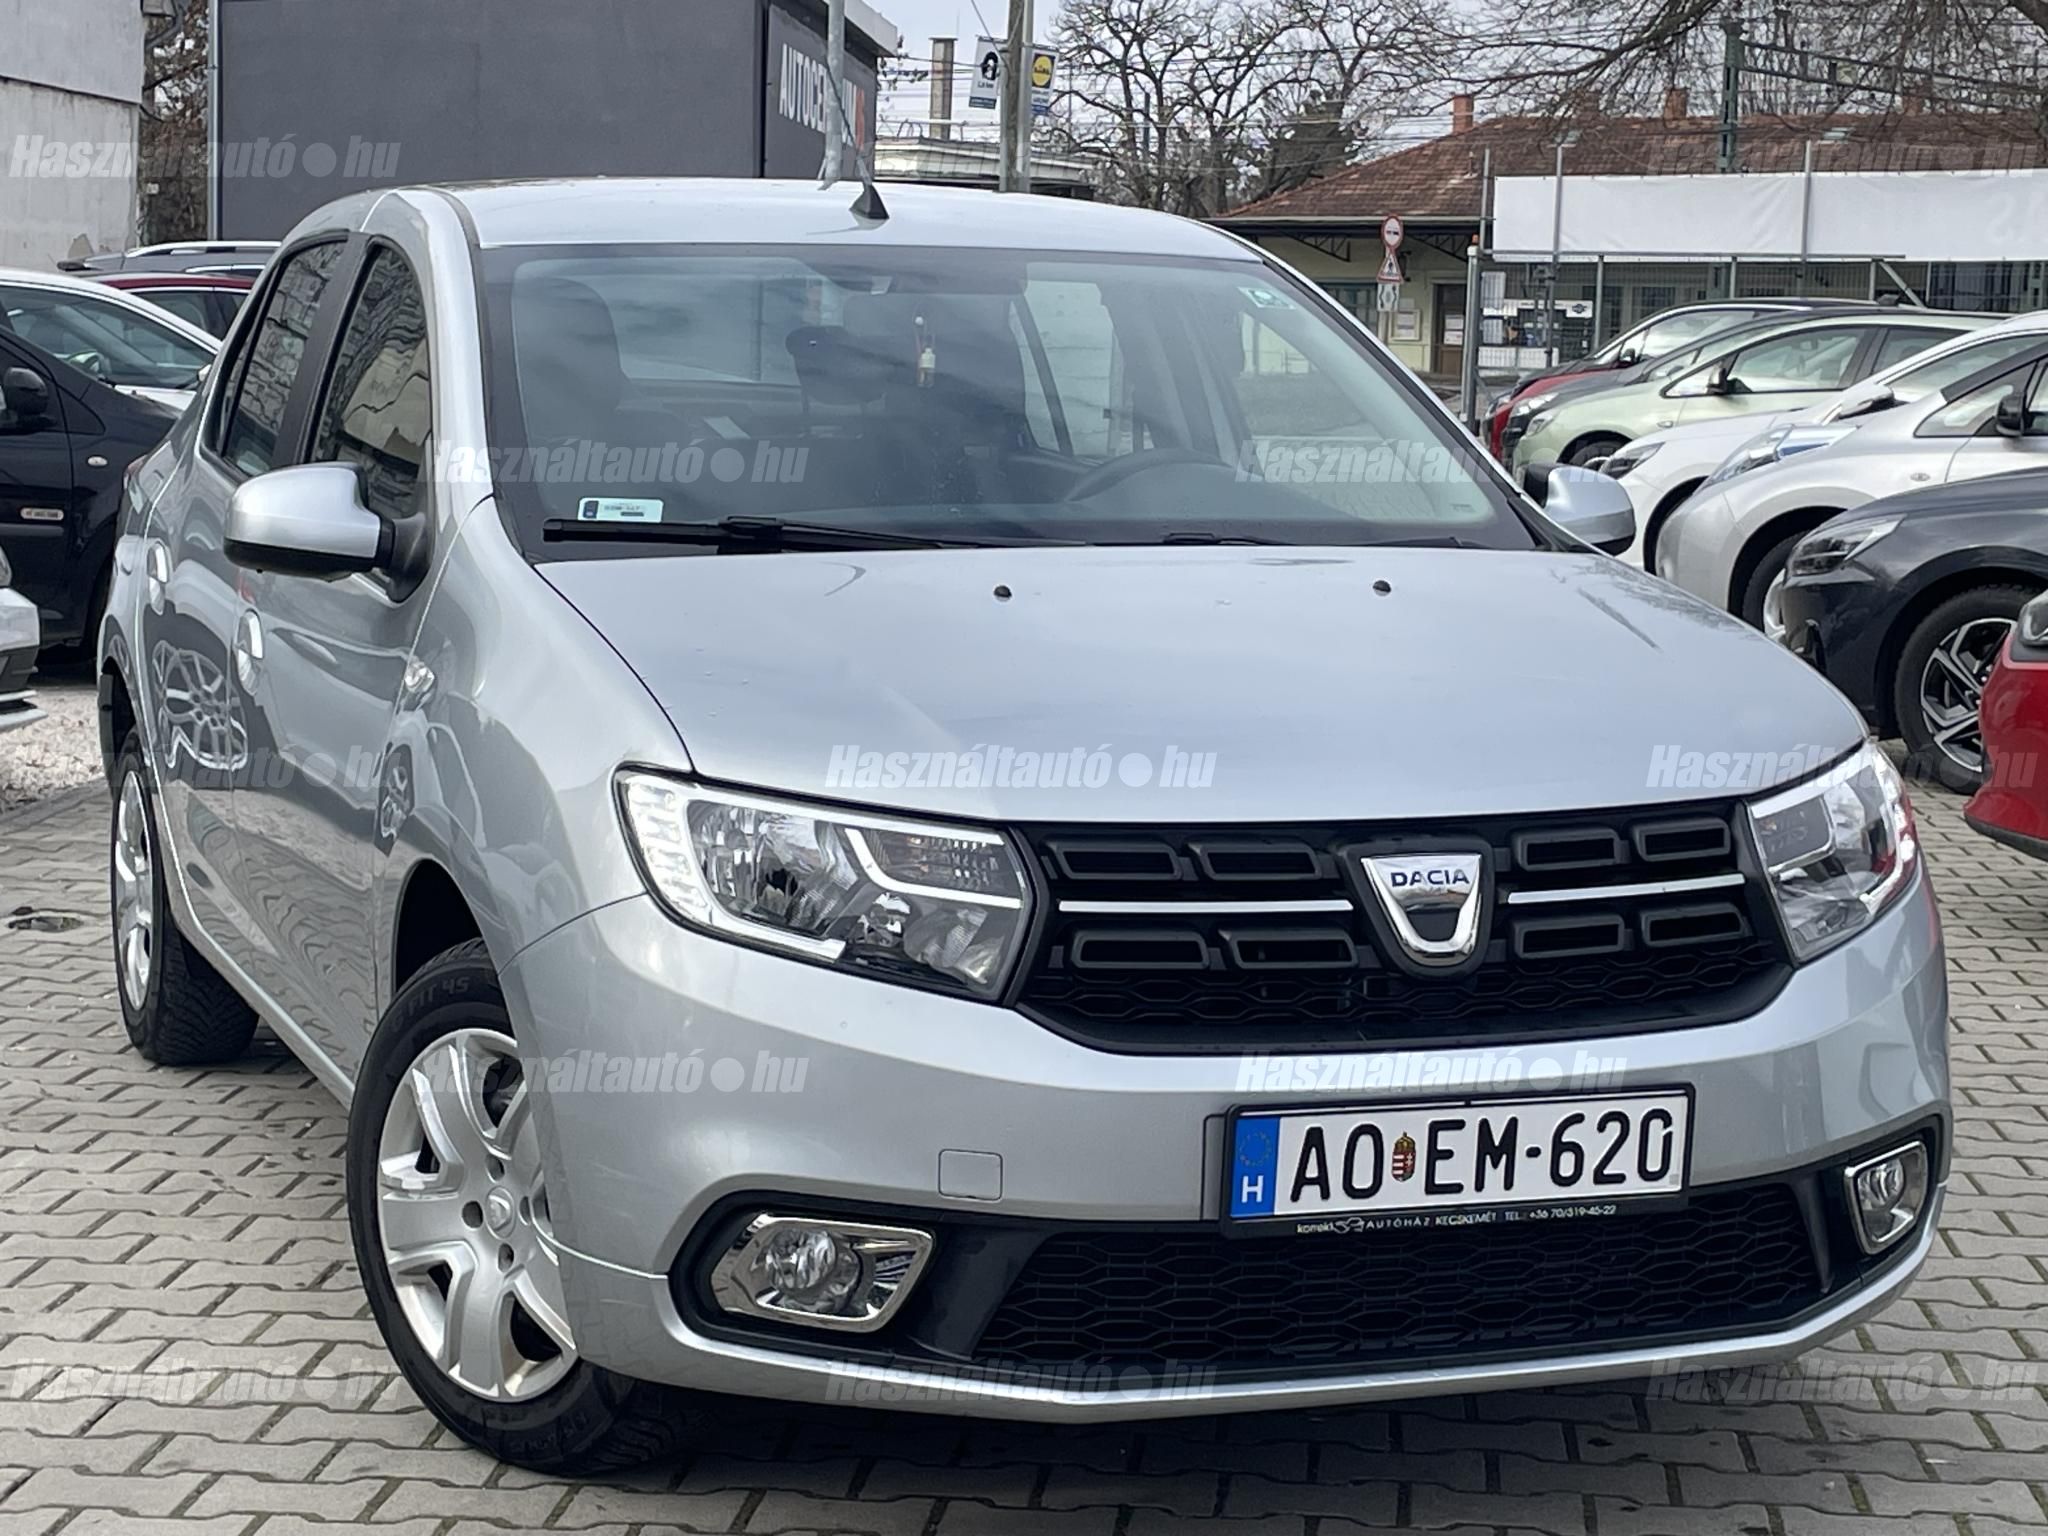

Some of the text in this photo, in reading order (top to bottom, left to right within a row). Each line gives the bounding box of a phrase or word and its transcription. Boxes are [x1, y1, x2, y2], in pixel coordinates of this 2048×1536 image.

[1390, 869, 1470, 887] DACIA
[1289, 1108, 1673, 1202] AO EM-620
[1241, 1175, 1264, 1203] H
[1435, 1211, 1497, 1226] KECSKEMÉT
